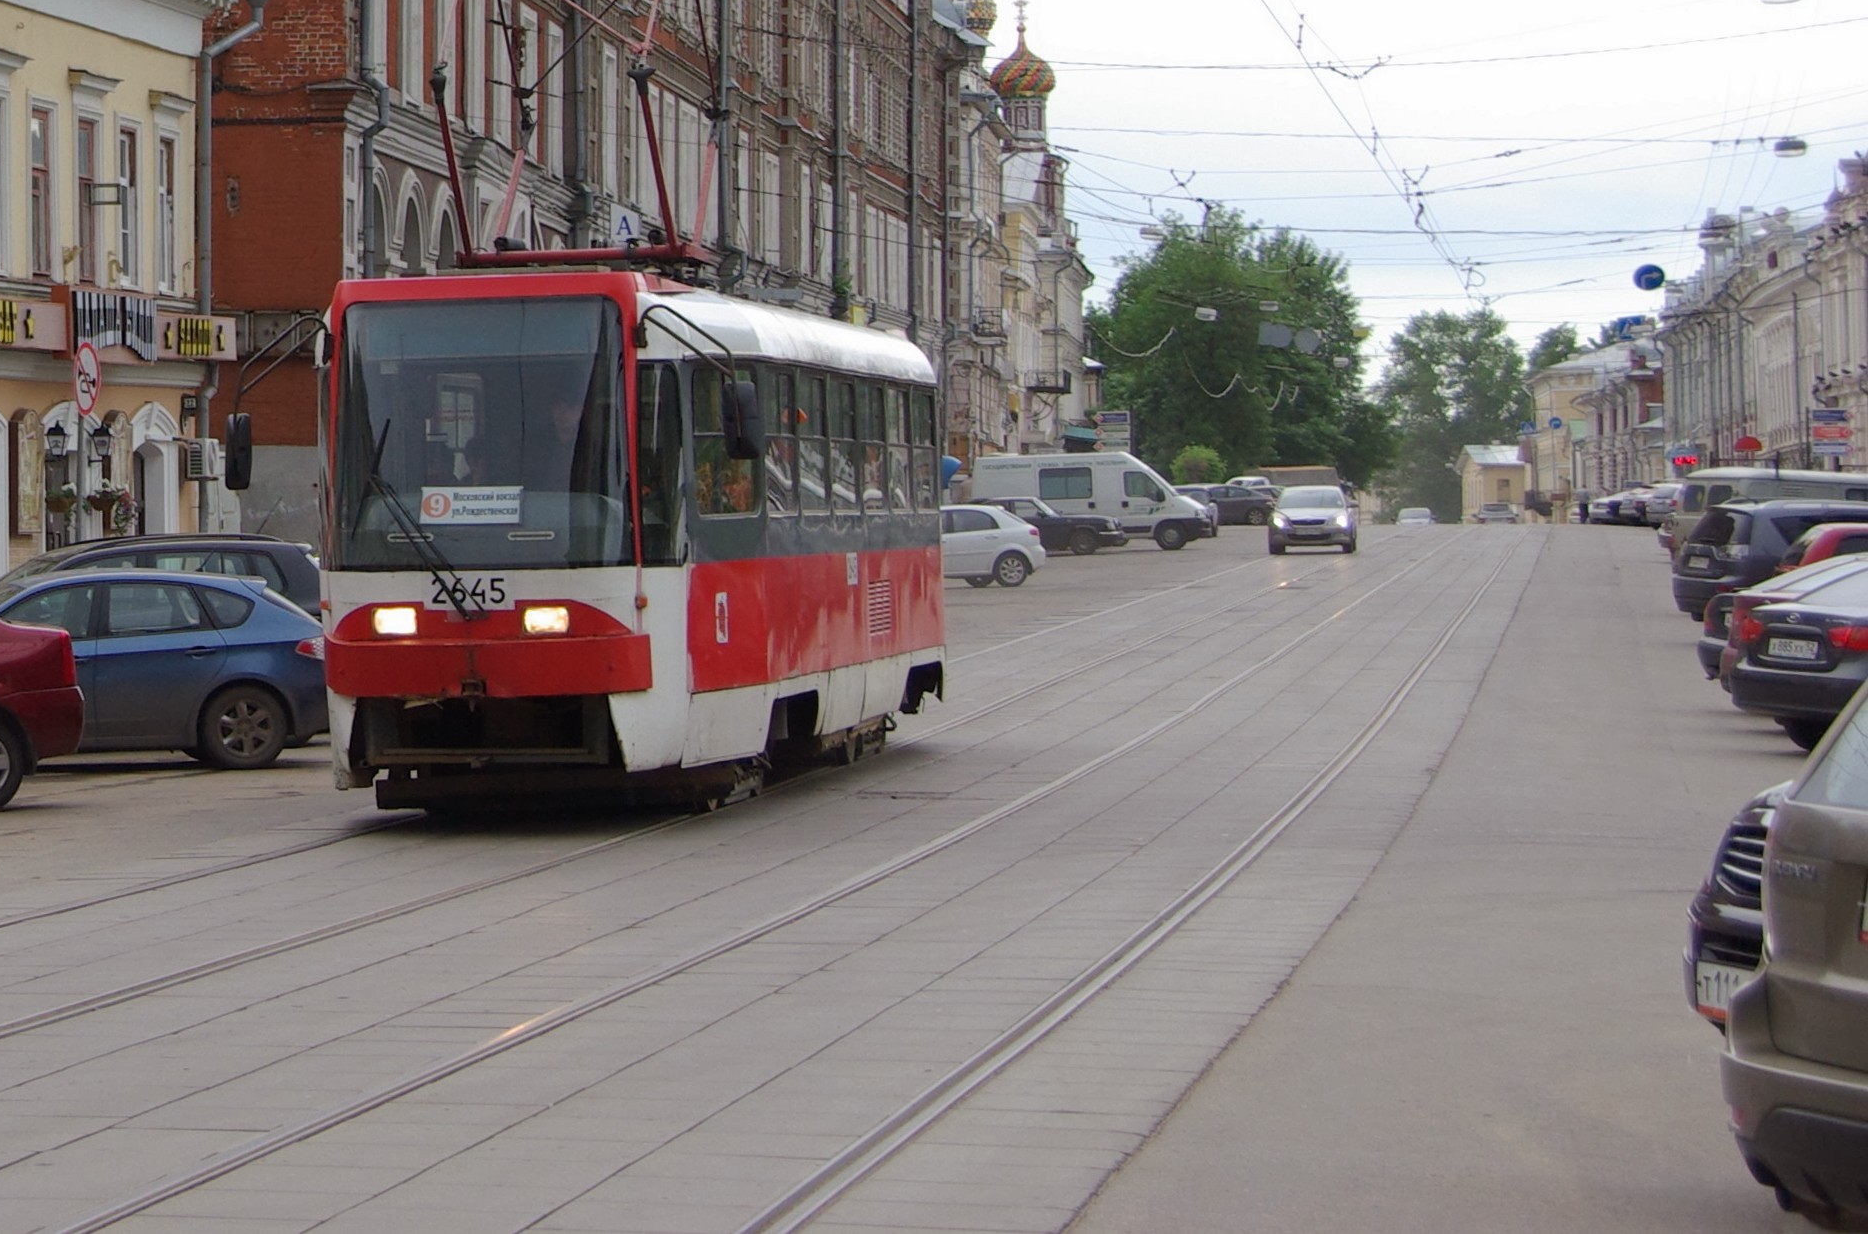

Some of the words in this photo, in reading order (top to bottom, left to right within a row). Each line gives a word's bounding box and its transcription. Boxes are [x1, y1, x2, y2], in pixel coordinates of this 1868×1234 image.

[429, 493, 446, 517] 9
[453, 490, 495, 501] Московский
[432, 577, 506, 604] 2645
